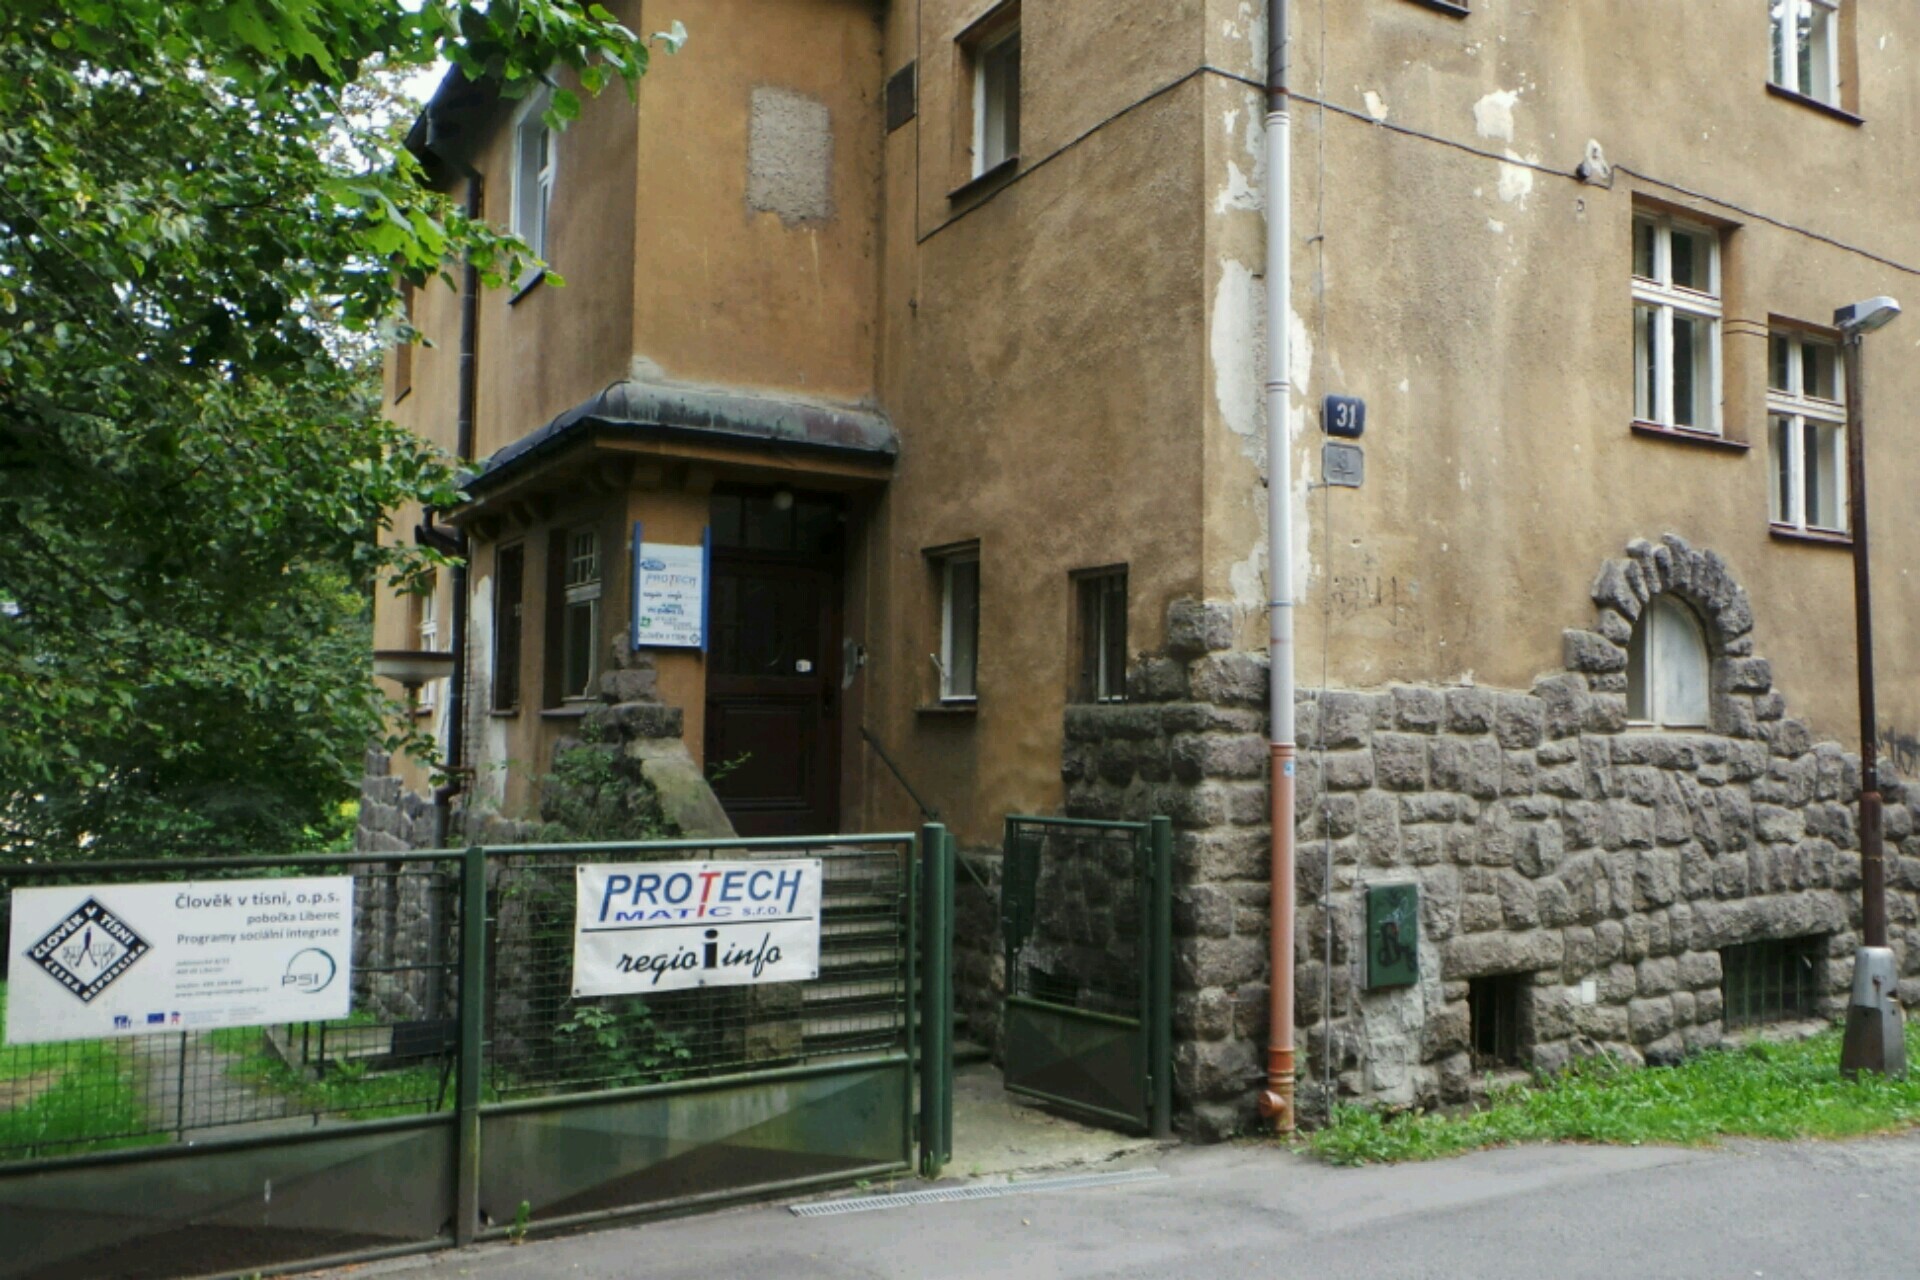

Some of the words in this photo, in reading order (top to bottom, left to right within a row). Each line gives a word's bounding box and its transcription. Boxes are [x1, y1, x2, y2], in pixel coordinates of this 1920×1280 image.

[1336, 402, 1356, 429] 31
[175, 893, 232, 909] Člověk
[237, 896, 247, 906] v
[296, 892, 340, 906] o.p.s.
[599, 869, 803, 922] PROTECH
[85, 905, 98, 917] V
[247, 911, 296, 925] pobočka
[300, 911, 340, 922] Liberec
[742, 906, 781, 917] s.r.o.
[177, 933, 237, 946] Programy
[240, 928, 283, 941] sociální
[286, 927, 340, 939] integrace
[616, 946, 699, 985] regio
[722, 932, 783, 978] info
[282, 973, 319, 987] PSI
